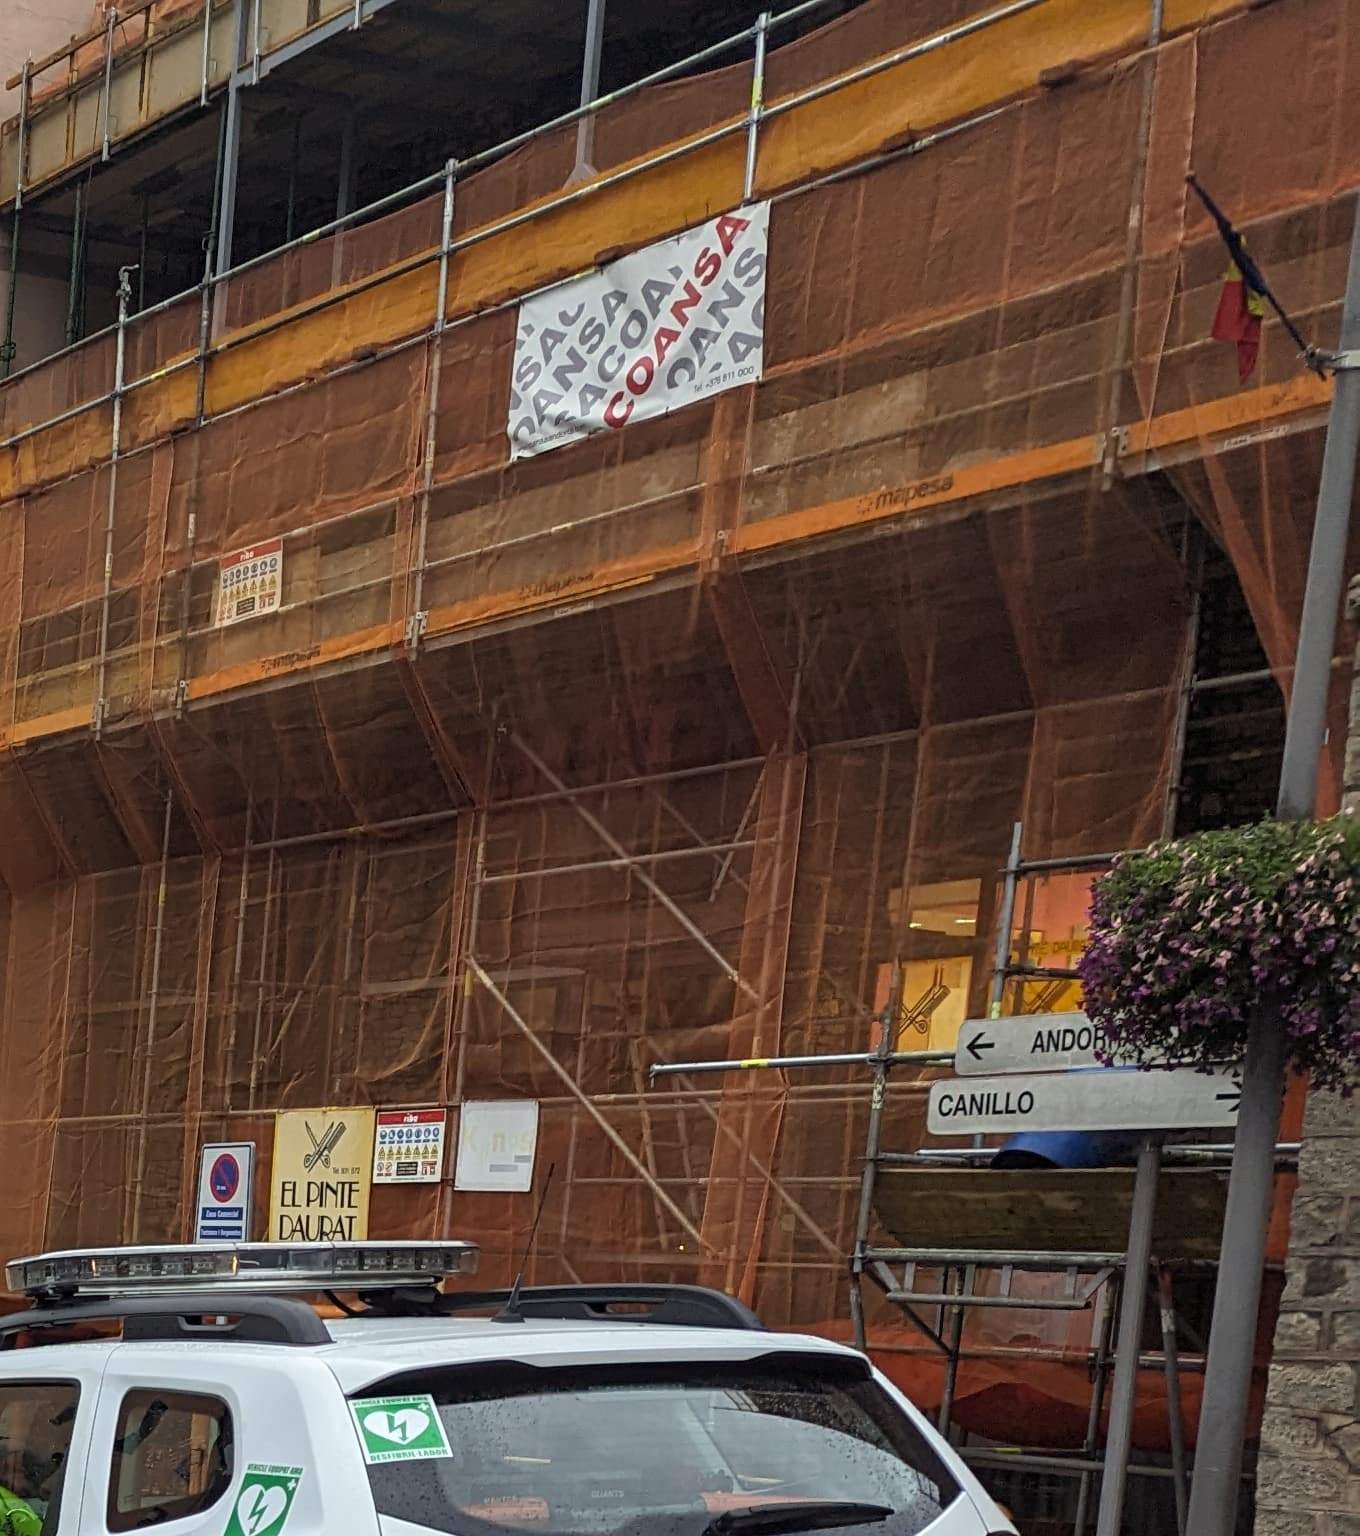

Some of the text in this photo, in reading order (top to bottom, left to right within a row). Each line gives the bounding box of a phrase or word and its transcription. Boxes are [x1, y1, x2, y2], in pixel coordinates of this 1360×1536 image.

[603, 214, 752, 430] COANSA
[937, 1090, 1034, 1117] CANILLO
[280, 1181, 302, 1208] EL
[279, 1214, 358, 1241] DAURAT
